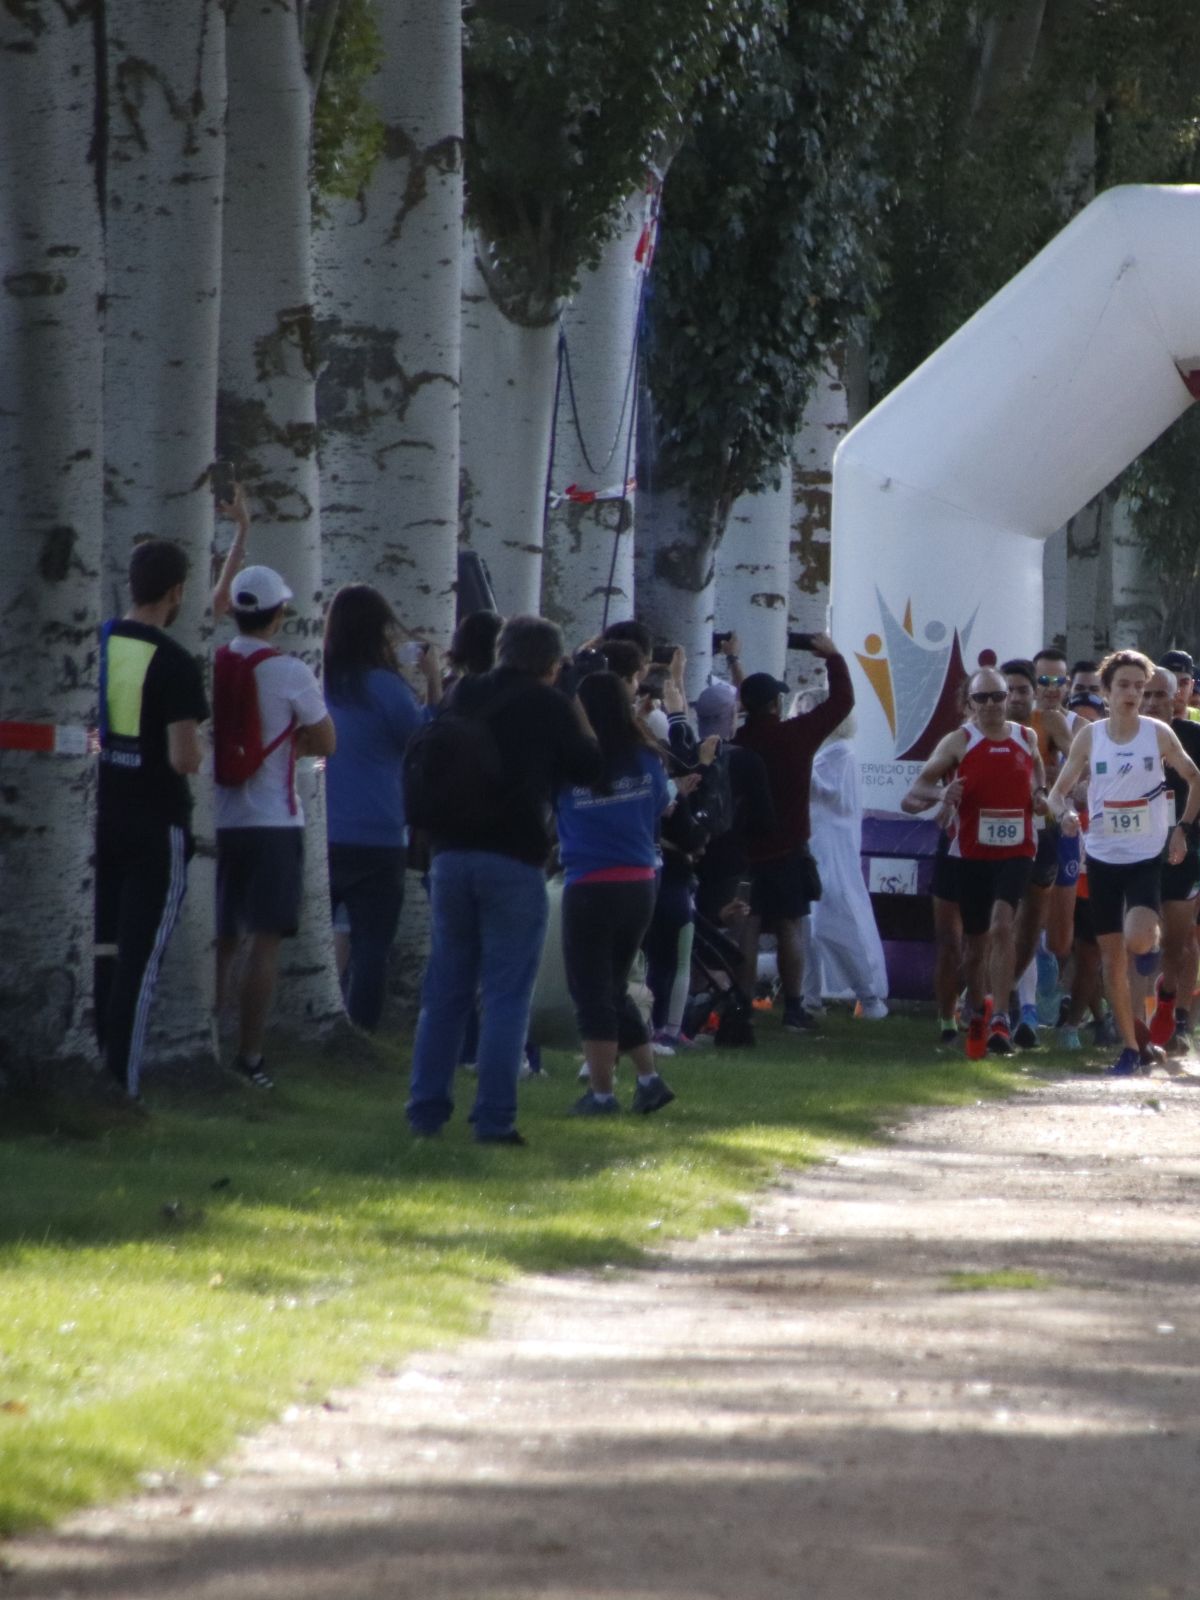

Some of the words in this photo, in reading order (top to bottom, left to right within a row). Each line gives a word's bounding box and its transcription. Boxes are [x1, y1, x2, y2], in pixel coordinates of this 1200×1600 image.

[861, 763, 904, 774] ERVICIO
[1111, 814, 1140, 828] 191
[988, 825, 1017, 838] 189
